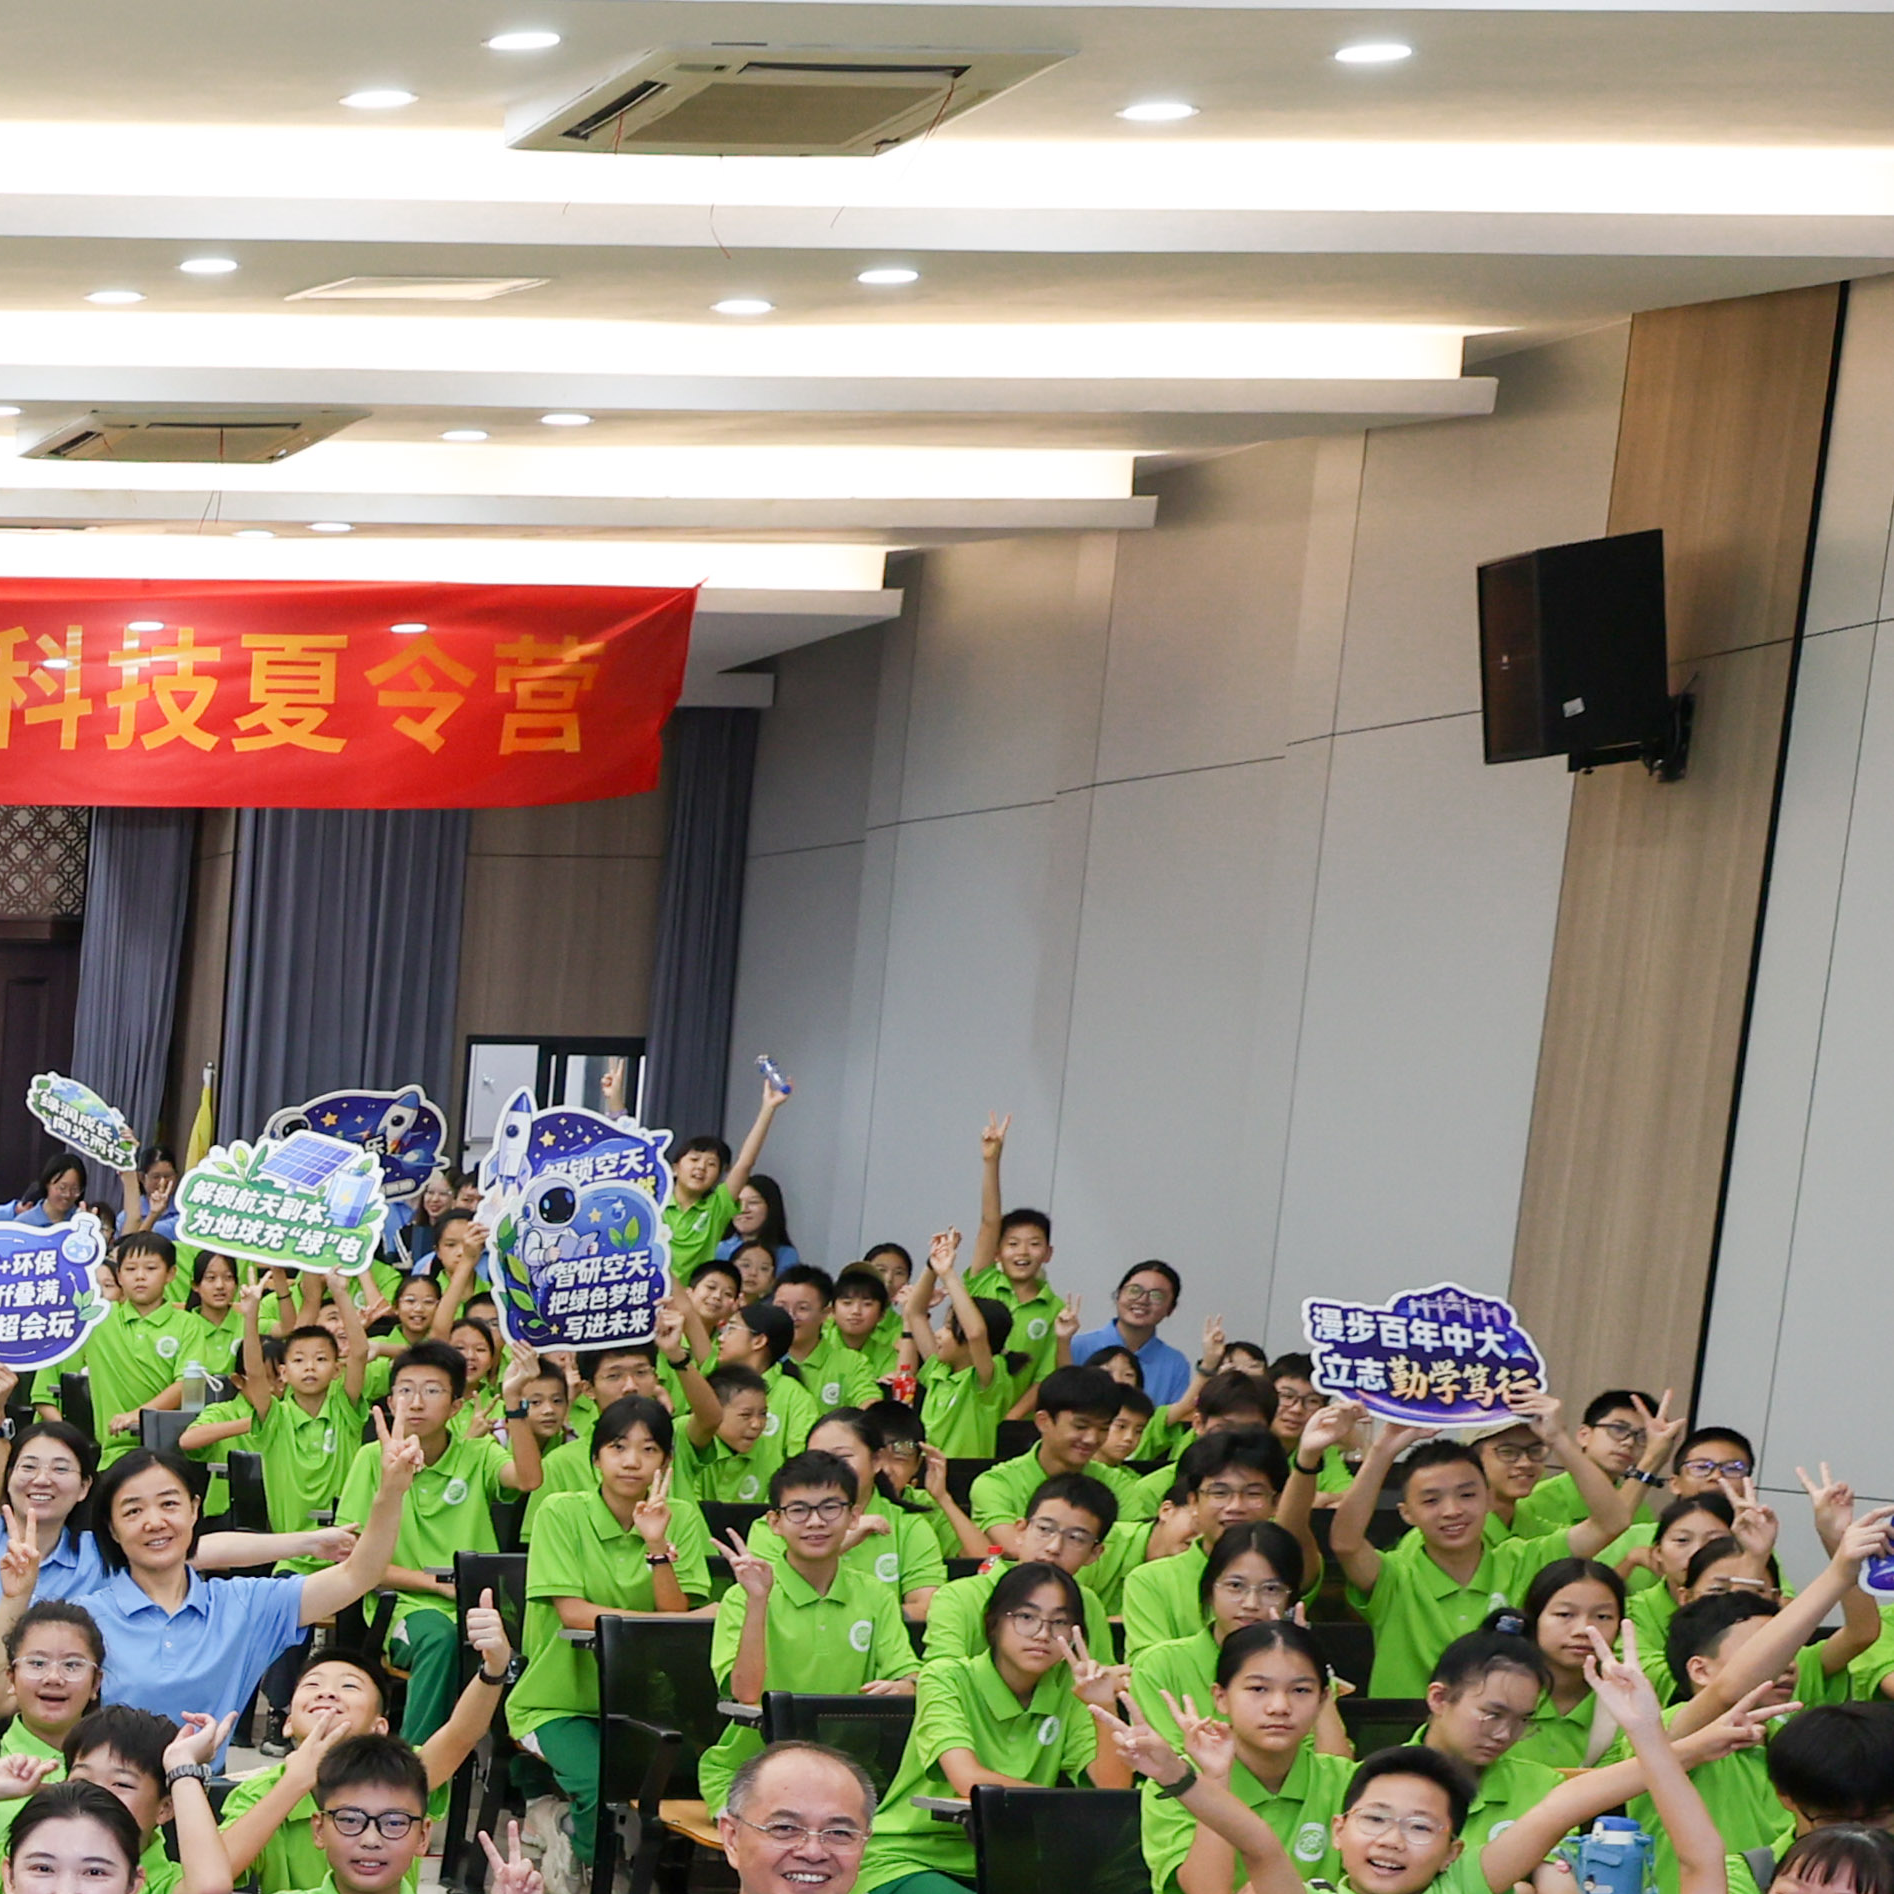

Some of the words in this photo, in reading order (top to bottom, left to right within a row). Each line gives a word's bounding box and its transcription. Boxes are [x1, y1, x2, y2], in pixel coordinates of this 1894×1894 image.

[53, 1116, 126, 1164] 向光而行
[188, 1180, 331, 1228] 解锁航天副本，
[548, 1249, 656, 1289] 智研空天，
[548, 1280, 649, 1316] 把绿色梦想
[563, 1308, 651, 1341] 写进未来
[1312, 1306, 1509, 1361] 漫步百年中大
[1321, 1353, 1537, 1408] 立志勤学笃行
